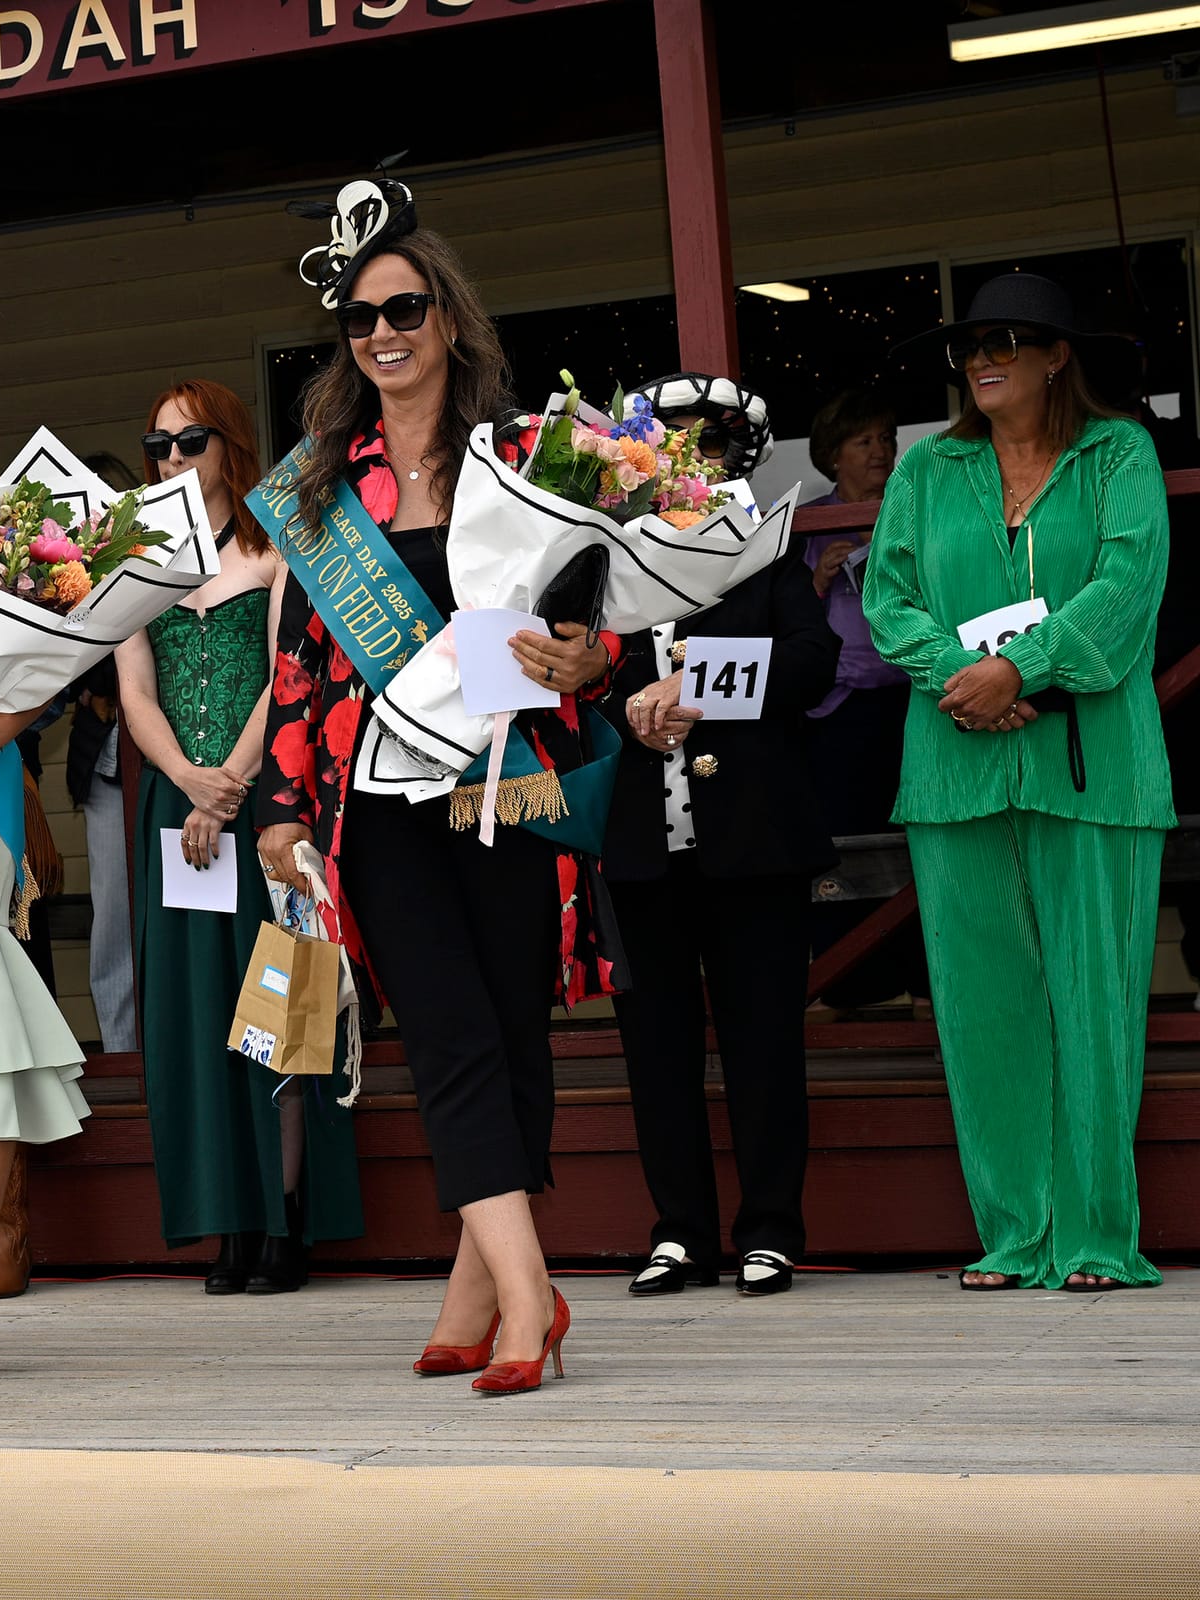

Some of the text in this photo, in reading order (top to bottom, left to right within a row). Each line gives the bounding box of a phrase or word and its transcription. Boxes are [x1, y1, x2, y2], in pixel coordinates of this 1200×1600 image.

[318, 554, 359, 600] ON
[330, 506, 415, 621] RACE DAY 2025
[333, 582, 403, 659] FIELD
[689, 660, 759, 699] 141
